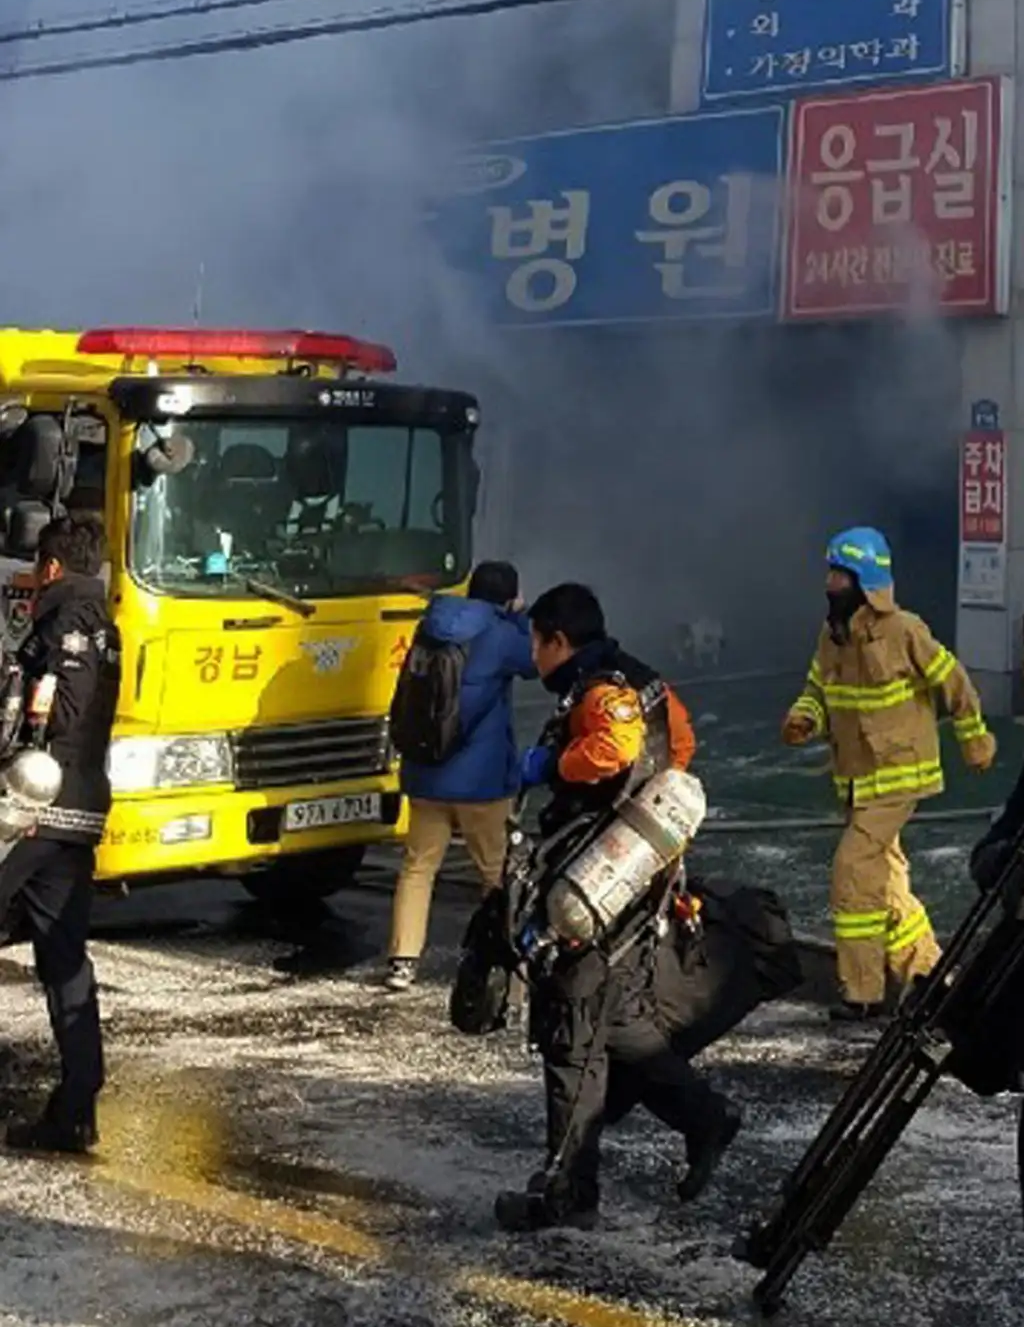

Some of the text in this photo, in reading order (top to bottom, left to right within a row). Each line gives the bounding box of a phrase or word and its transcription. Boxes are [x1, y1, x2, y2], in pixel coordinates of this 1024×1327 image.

[811, 108, 979, 232] 응급실
[487, 174, 749, 312] 병원
[194, 645, 262, 683] 경남
